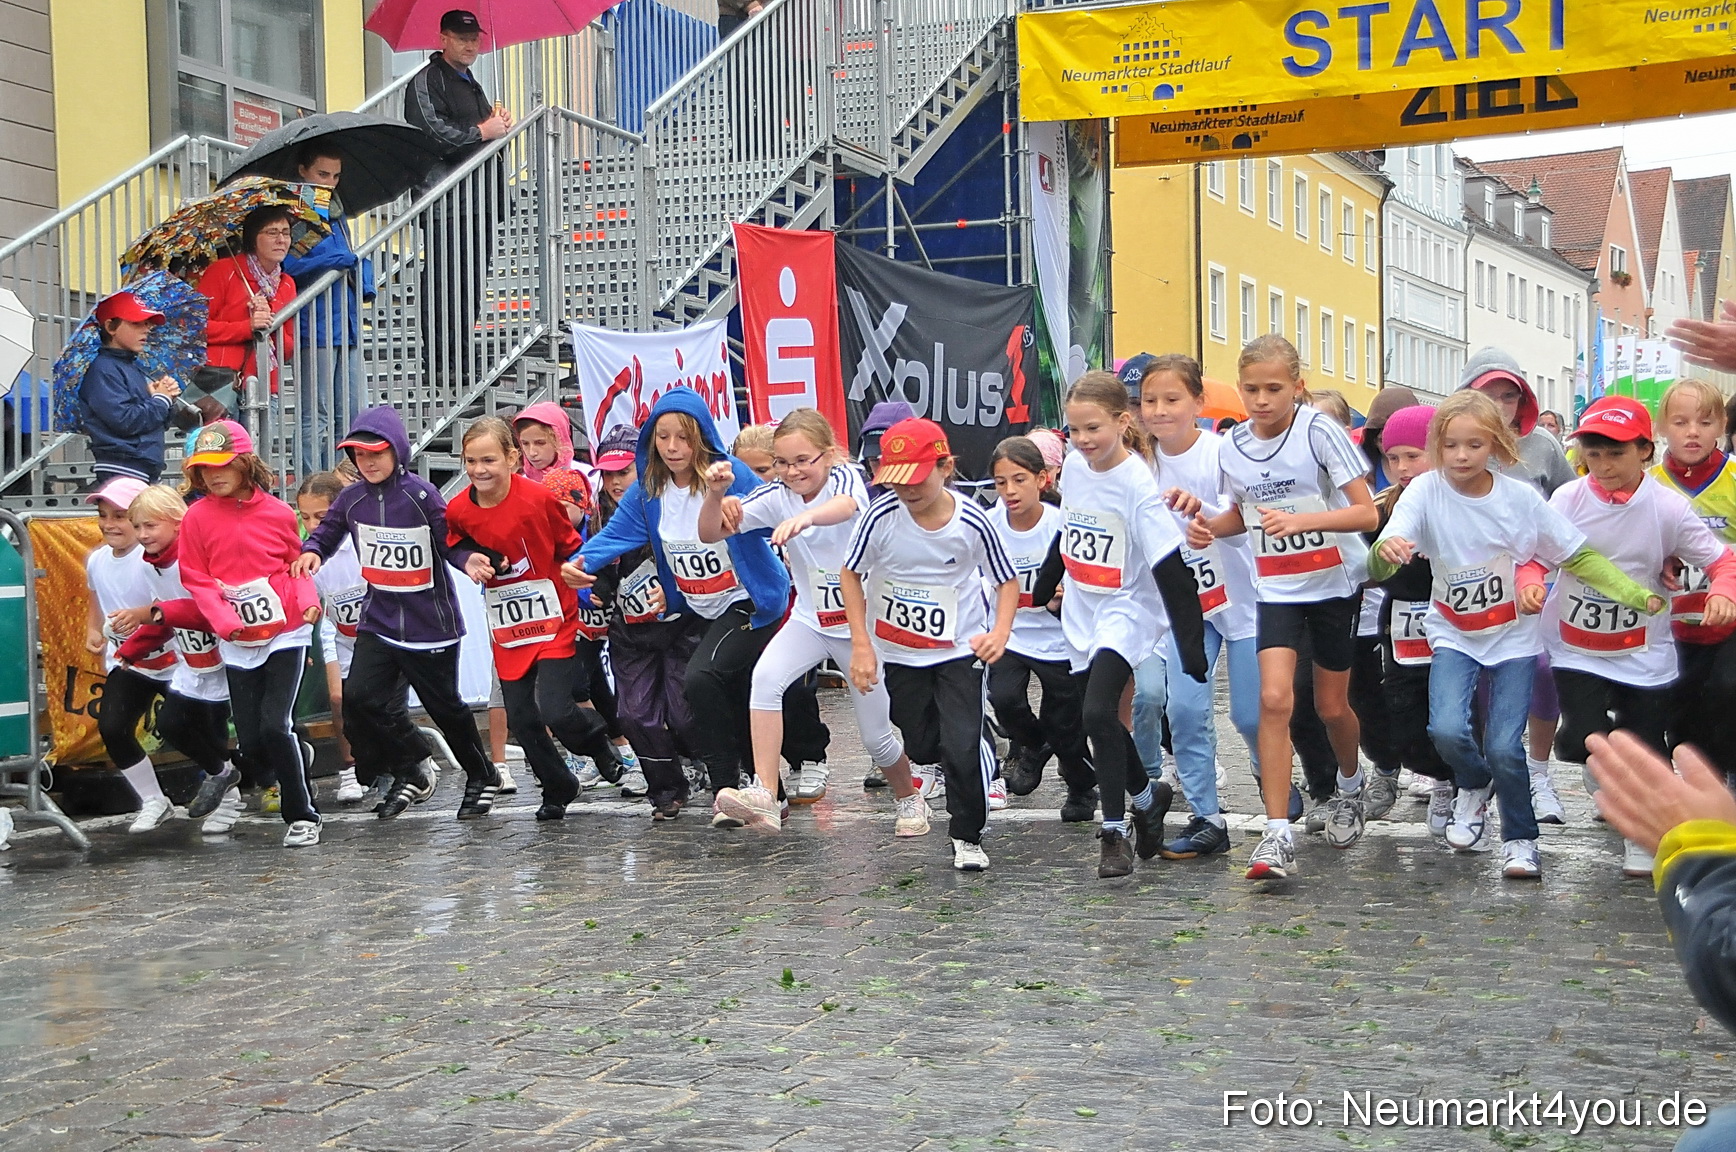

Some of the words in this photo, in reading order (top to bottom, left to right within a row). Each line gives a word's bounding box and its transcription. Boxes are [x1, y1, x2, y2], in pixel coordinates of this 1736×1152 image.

[1281, 0, 1566, 78] START
[1061, 63, 1155, 83] Neumarkter
[1159, 55, 1233, 77] Stadtlauf
[1150, 116, 1235, 134] Neumarkter
[1236, 109, 1306, 128] Stadtlauf
[1254, 487, 1291, 498] LANGE
[366, 543, 424, 569] 7290
[490, 594, 550, 626] 7071
[881, 594, 946, 637] 7339
[1568, 594, 1639, 631] 7313
[511, 623, 547, 639] Leonie
